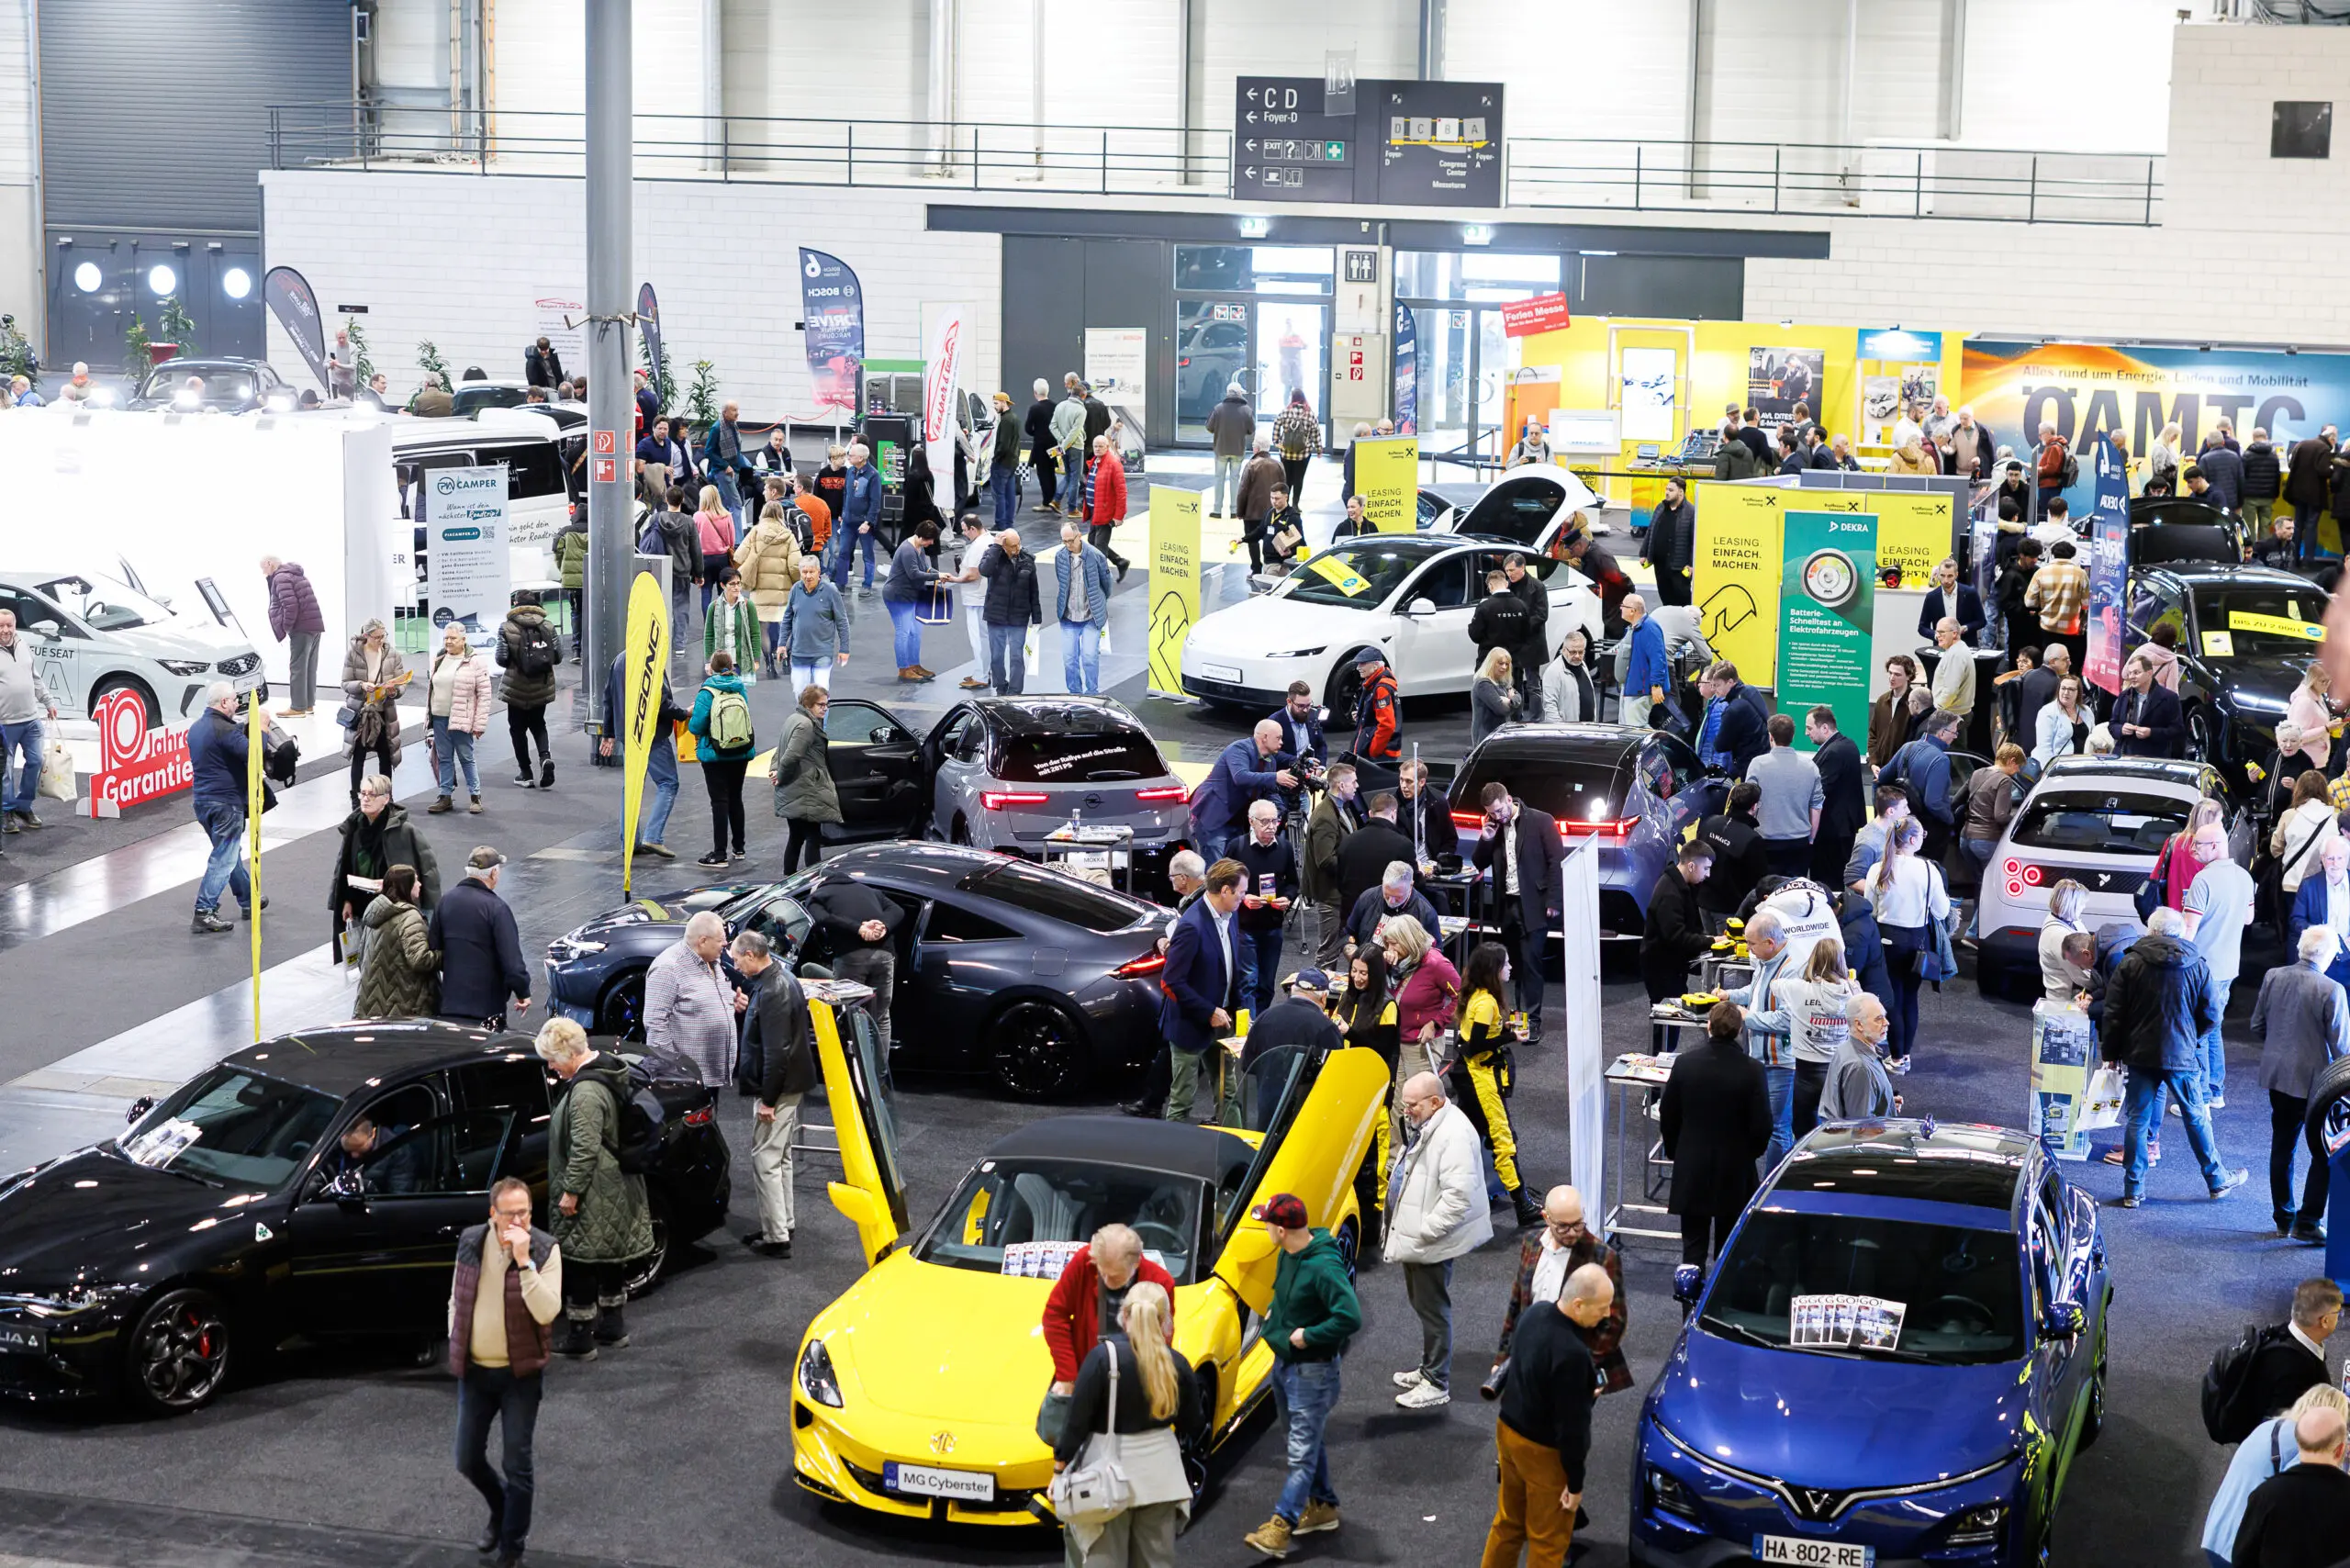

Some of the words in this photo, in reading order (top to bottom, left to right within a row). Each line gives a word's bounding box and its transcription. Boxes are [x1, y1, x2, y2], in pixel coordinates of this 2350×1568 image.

[1264, 88, 1277, 109] C
[1285, 88, 1298, 109] D
[1263, 111, 1298, 124] Foyer-D
[1471, 123, 1479, 135] A
[1264, 141, 1282, 151] EXIT
[1505, 310, 1534, 322] Ferien
[1535, 305, 1564, 317] Messe
[2022, 366, 2053, 376] Alles
[2059, 369, 2087, 378] rund
[2093, 371, 2111, 379] um
[2219, 375, 2243, 386] und
[2248, 375, 2309, 387] Mobilität
[2022, 386, 2306, 458] ÖAMTC
[456, 479, 497, 489] CAMPER
[1367, 487, 1404, 498] LEASING.
[1367, 498, 1404, 509] EINFACH.
[1367, 510, 1403, 519] MACHEN.
[520, 521, 534, 532] geht
[536, 520, 549, 528] dein
[1841, 522, 1869, 532] DEKRA
[1713, 536, 1762, 547] LEASING.
[1713, 548, 1762, 559] EINFACH.
[1883, 545, 1932, 555] LEASING.
[1160, 554, 1191, 566] EINFACH.
[1712, 560, 1762, 571] MACHEN.
[1883, 557, 1932, 567] EINFACH.
[1160, 566, 1191, 578] MACHEN.
[1790, 609, 1824, 617] Batterie-
[1790, 617, 1831, 626] Schnelltest
[1789, 625, 1859, 637] Elektrofahrzeugen
[29, 645, 48, 656] UE
[50, 648, 74, 659] SEAT
[633, 619, 660, 745] ZGONC
[91, 688, 147, 773] 10
[1034, 762, 1048, 770] Von
[1060, 754, 1081, 763] Rallye
[1103, 746, 1127, 755] Straße
[102, 756, 194, 804] Garantie
[1775, 881, 1805, 895] BLACK
[1783, 923, 1830, 935] WORLDWIDE
[1859, 1296, 1883, 1307] GO!
[903, 1473, 925, 1485] MG
[928, 1475, 989, 1493] Cyberster
[1765, 1540, 1862, 1567] HA-802-RE
